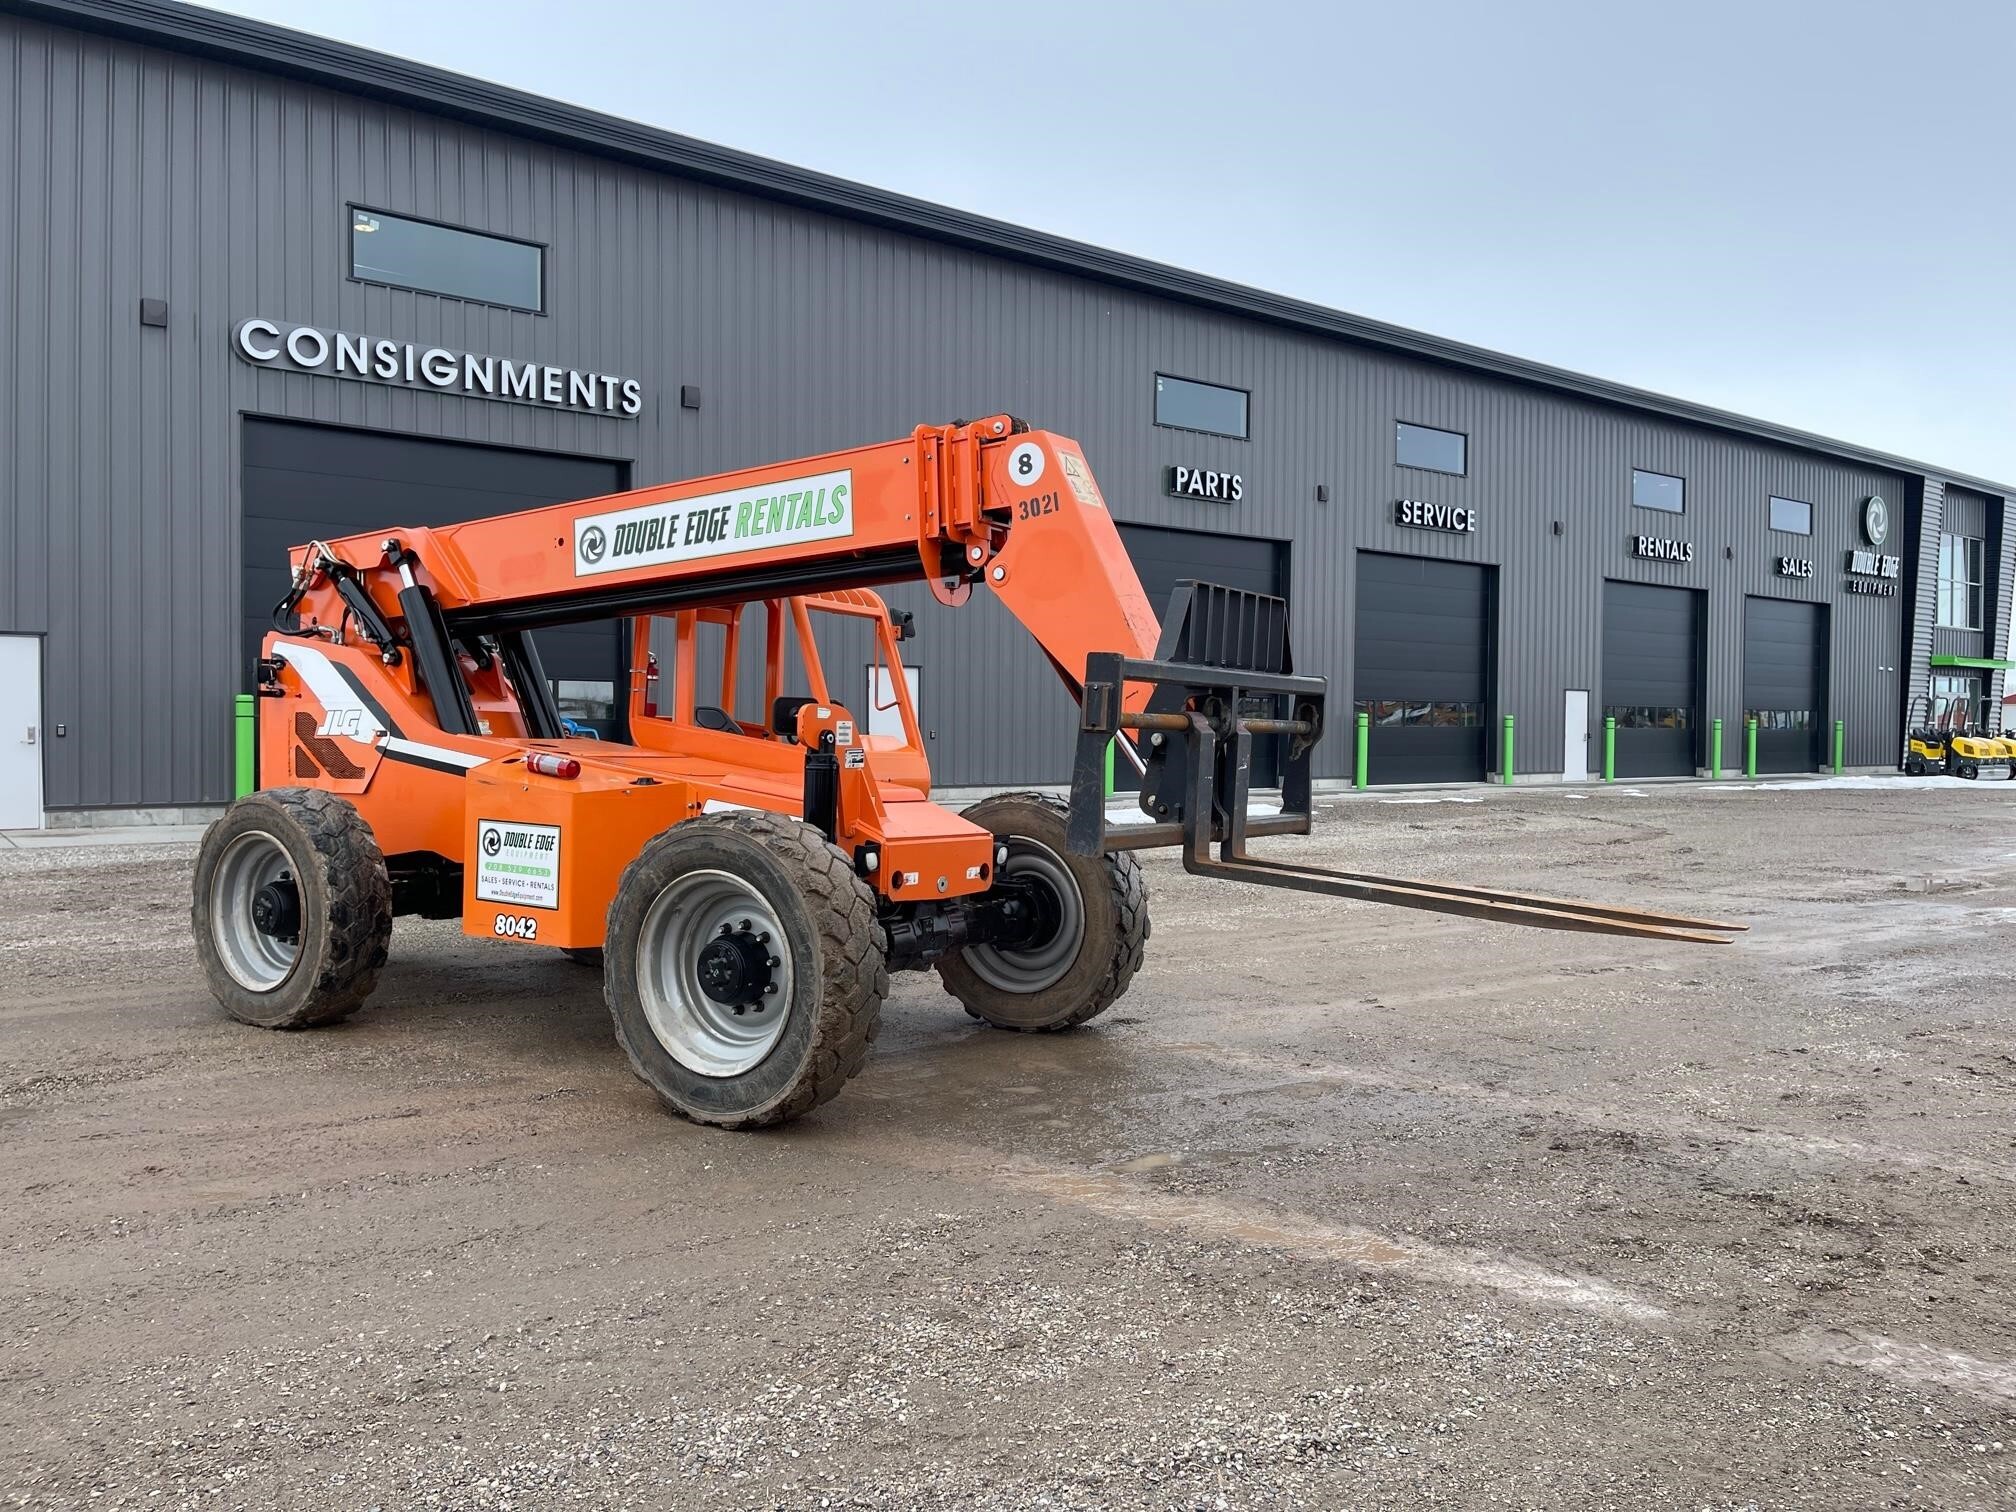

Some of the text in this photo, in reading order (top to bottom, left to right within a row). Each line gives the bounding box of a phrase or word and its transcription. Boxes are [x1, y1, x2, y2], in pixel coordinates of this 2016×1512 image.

[239, 319, 642, 415] CONSIGNMENTS
[1018, 453, 1033, 475] 8
[1175, 466, 1243, 501] PARTS
[1018, 491, 1060, 521] 3021
[1402, 499, 1476, 532] SERVICE
[612, 484, 848, 557] DOUBLE EDGE RENTALS
[1638, 535, 1693, 562] RENTALS
[1781, 556, 1813, 579] SALES
[1851, 550, 1900, 579] DOUBLE EDGE
[1853, 580, 1897, 597] EQUIPMENT
[316, 708, 362, 737] JLG
[503, 831, 556, 851] DOUBLE EDGE
[481, 875, 555, 892] SALES SERVICE RENTALS
[494, 913, 538, 940] 8042
